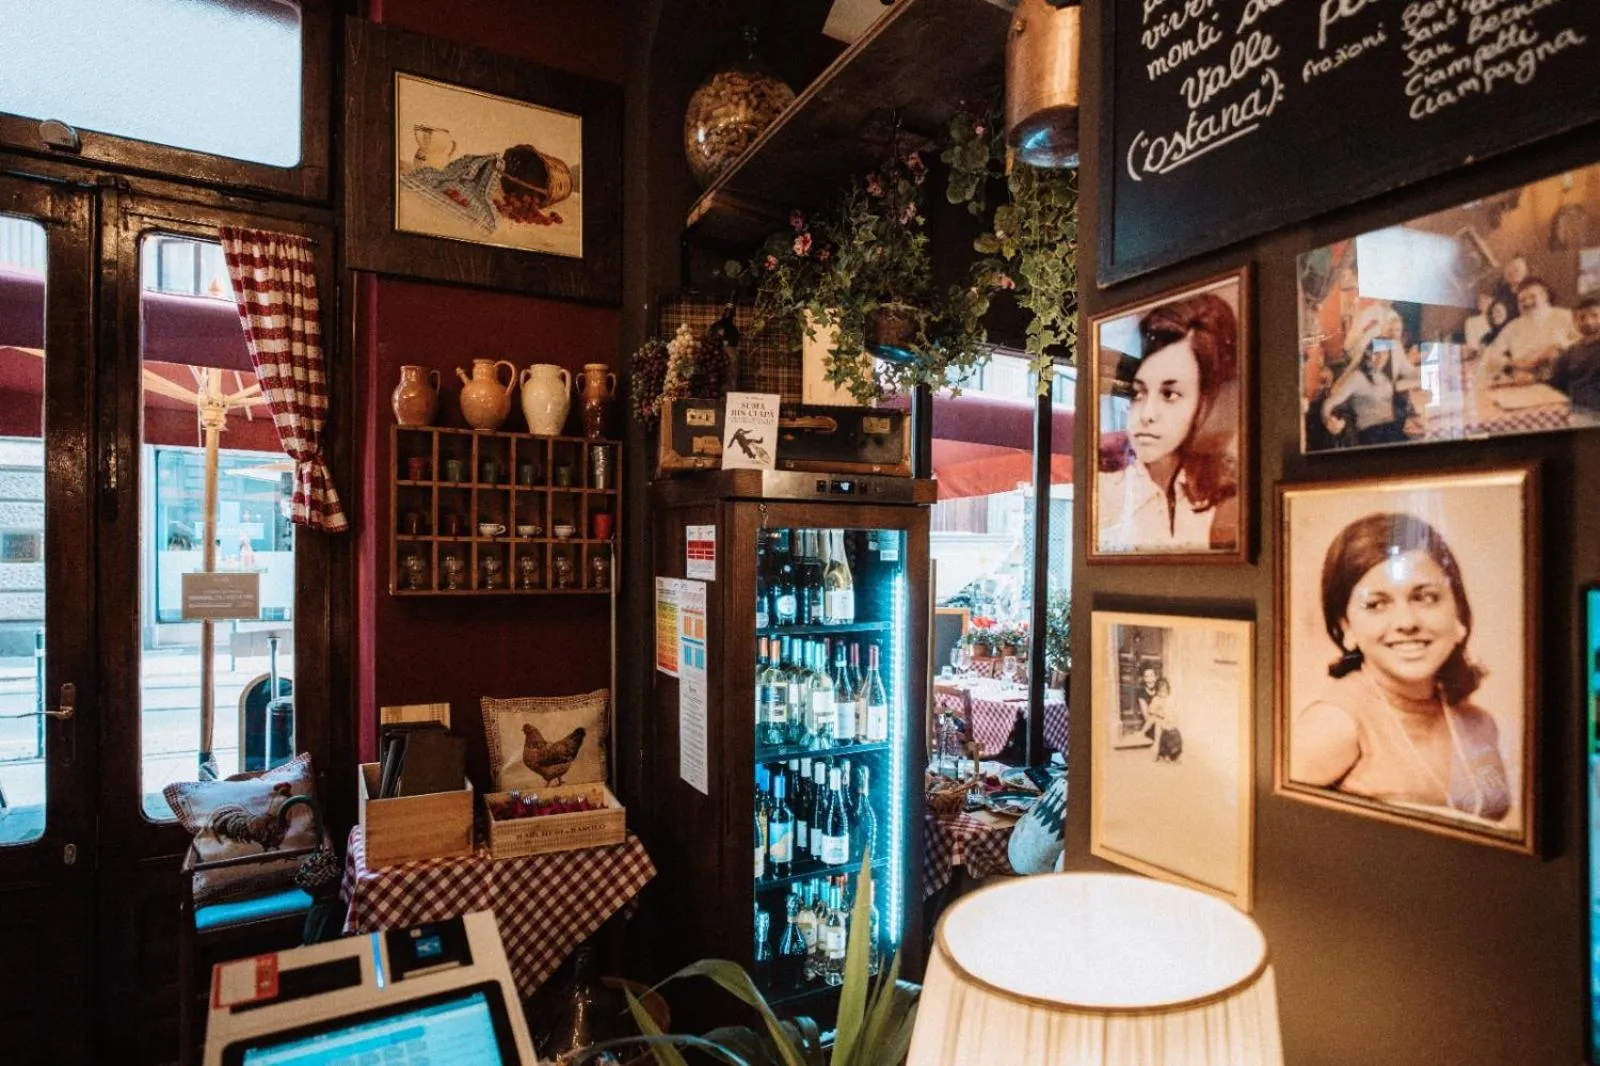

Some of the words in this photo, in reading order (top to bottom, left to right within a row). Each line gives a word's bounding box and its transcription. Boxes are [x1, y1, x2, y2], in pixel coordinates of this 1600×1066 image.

[1146, 12, 1223, 81] monti
[1179, 29, 1281, 109] Valle
[1402, 42, 1456, 77] San
[1404, 19, 1539, 96] Ciampetti
[1409, 28, 1587, 119] Ciampagna
